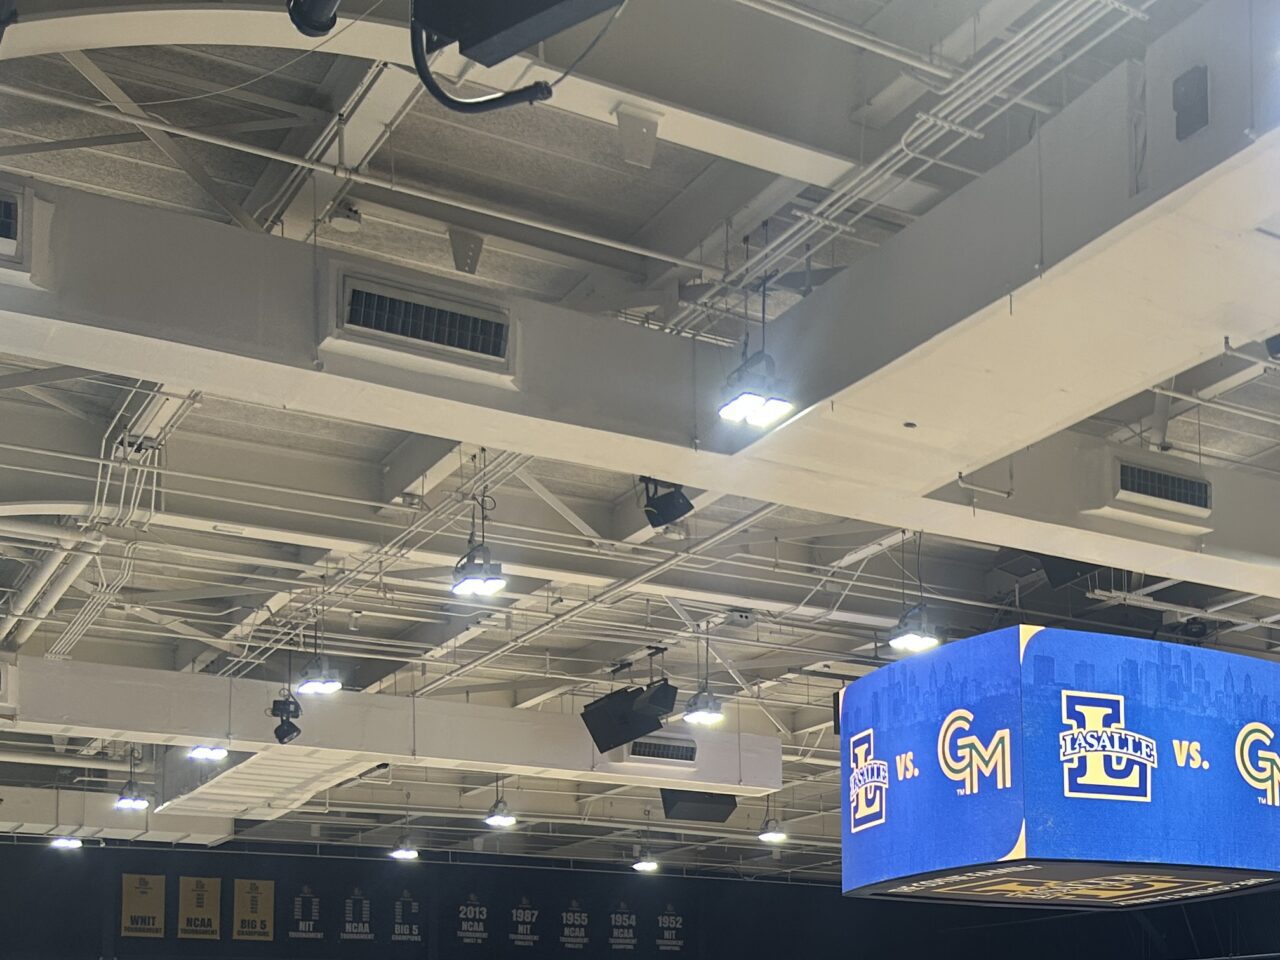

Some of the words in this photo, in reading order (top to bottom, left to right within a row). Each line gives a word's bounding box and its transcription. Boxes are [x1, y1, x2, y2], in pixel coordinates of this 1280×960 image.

[1062, 730, 1155, 764] LASALLE
[1172, 740, 1209, 770] VS.
[896, 749, 919, 781] VS.
[851, 761, 888, 797] LASALLE
[459, 906, 487, 919] 2013
[512, 909, 539, 922] 1987
[561, 912, 588, 925] 1955
[186, 917, 212, 928] NCAA
[240, 919, 257, 929] BIG
[260, 920, 267, 930] 5
[462, 921, 484, 931] NCAA
[610, 914, 636, 926] 1954
[657, 915, 683, 928] 1952
[345, 922, 370, 933] NCAA
[395, 924, 410, 934] BIG
[412, 925, 419, 935] 5
[564, 927, 585, 937] NCAA
[613, 928, 634, 938] NCAA
